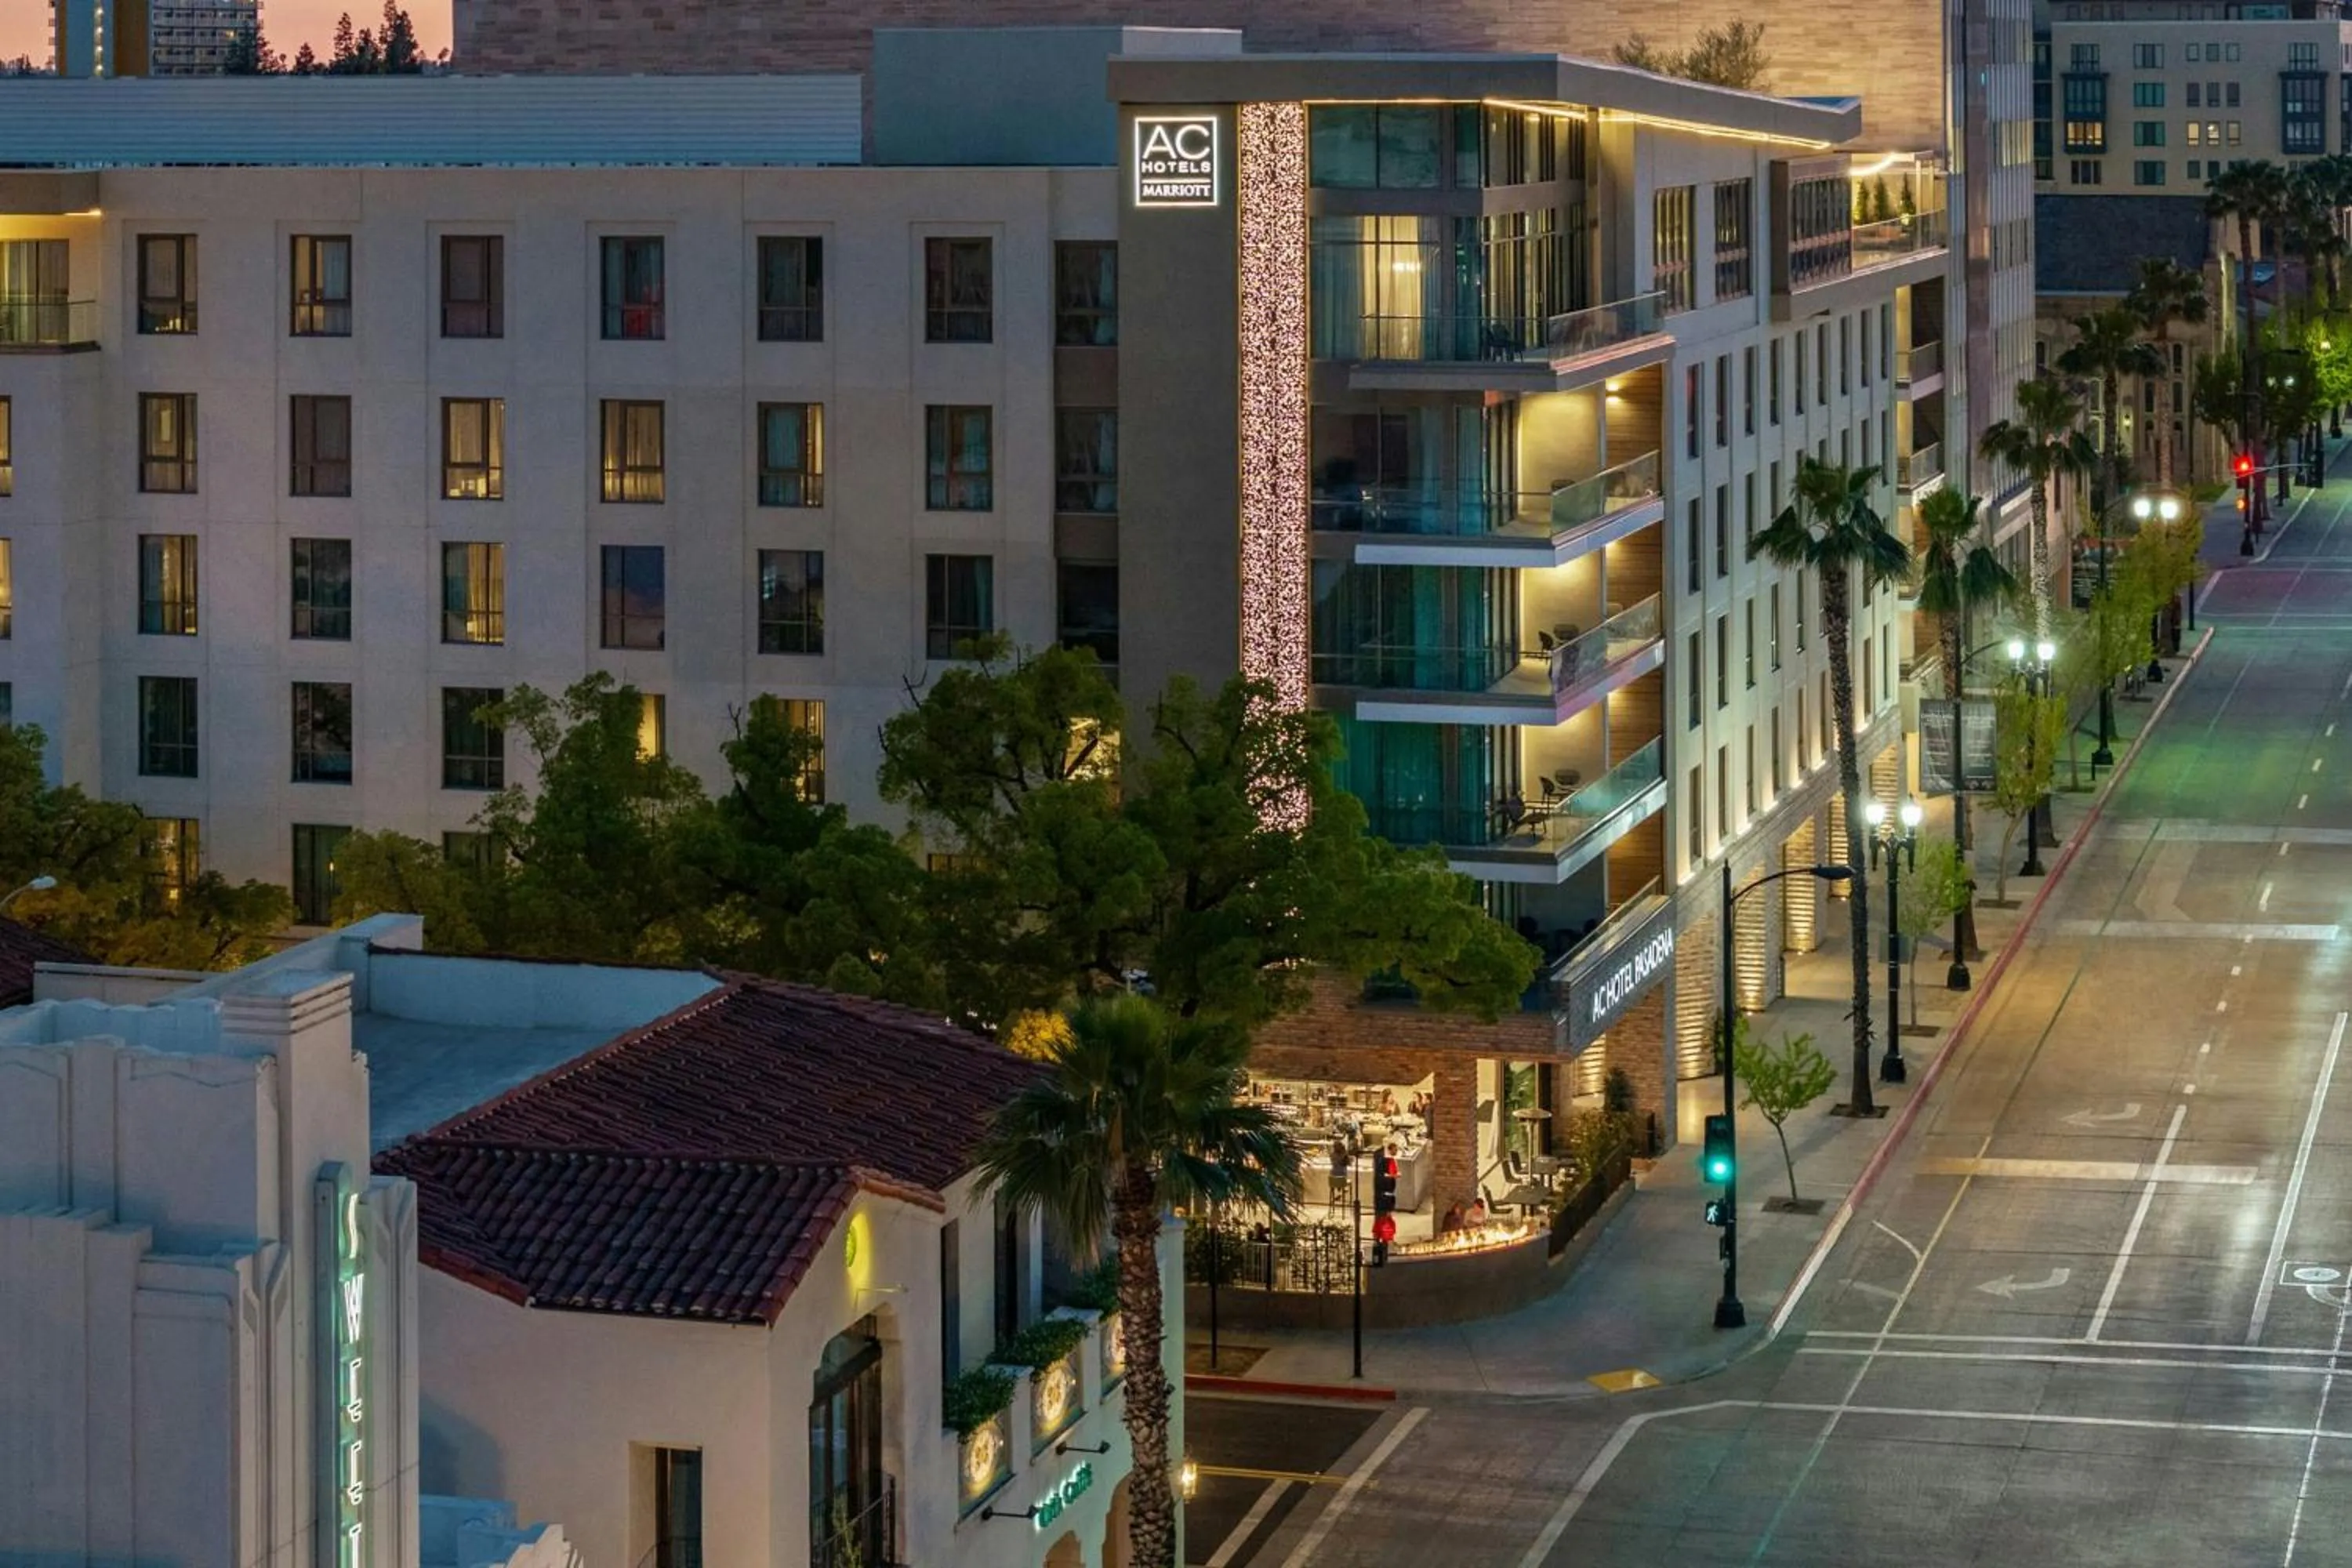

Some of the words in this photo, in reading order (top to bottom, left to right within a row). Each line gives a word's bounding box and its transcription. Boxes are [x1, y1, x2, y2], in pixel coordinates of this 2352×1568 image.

[1142, 124, 1211, 160] AC
[1141, 161, 1211, 173] HOTELS
[1142, 184, 1211, 197] MARRIOTT
[1592, 985, 1606, 1023] AC
[1606, 962, 1635, 1010] HOTEL
[1635, 927, 1674, 985] PASADENA
